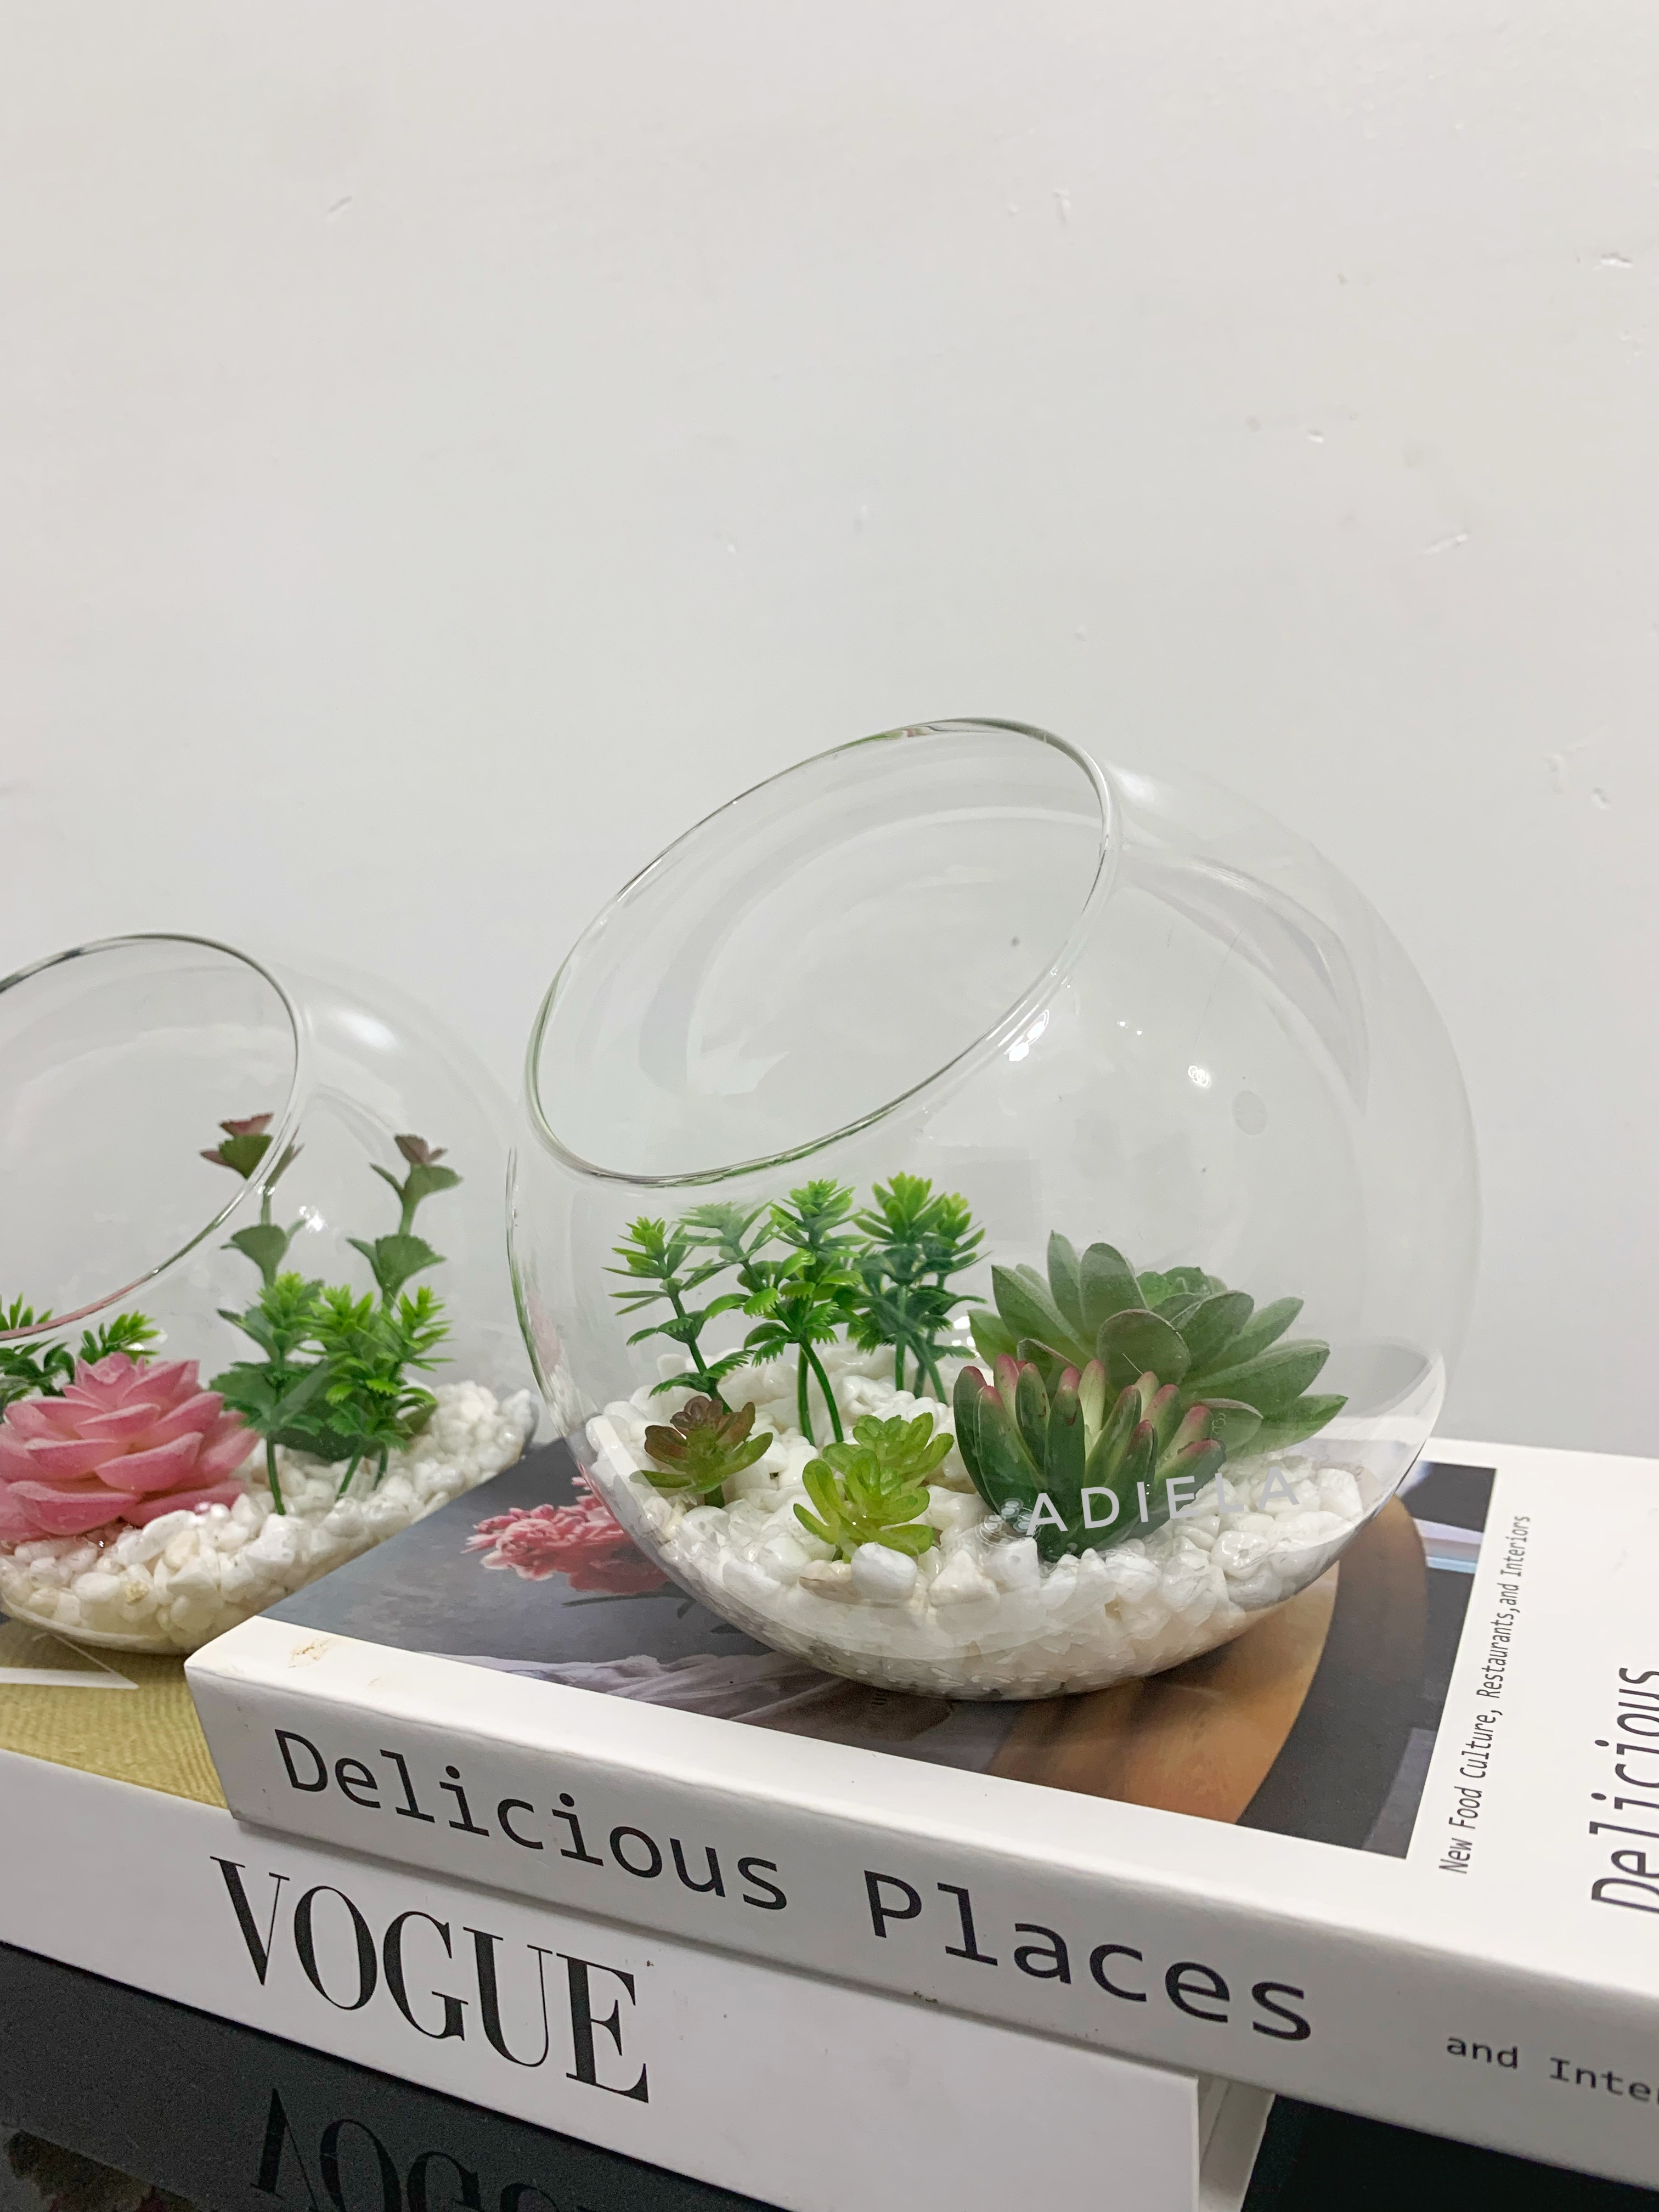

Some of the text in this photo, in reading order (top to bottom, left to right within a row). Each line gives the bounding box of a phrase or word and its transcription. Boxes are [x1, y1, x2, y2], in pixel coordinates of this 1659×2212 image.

[1500, 1515, 1531, 1577] Interiors
[1459, 1709, 1503, 1779] Culture,
[1448, 1786, 1482, 1830] Food
[274, 1728, 1312, 2041] Delicious Places
[1438, 1837, 1473, 1875] New
[210, 1856, 650, 2104] VOGUE
[1446, 2037, 1659, 2107] and Inte
